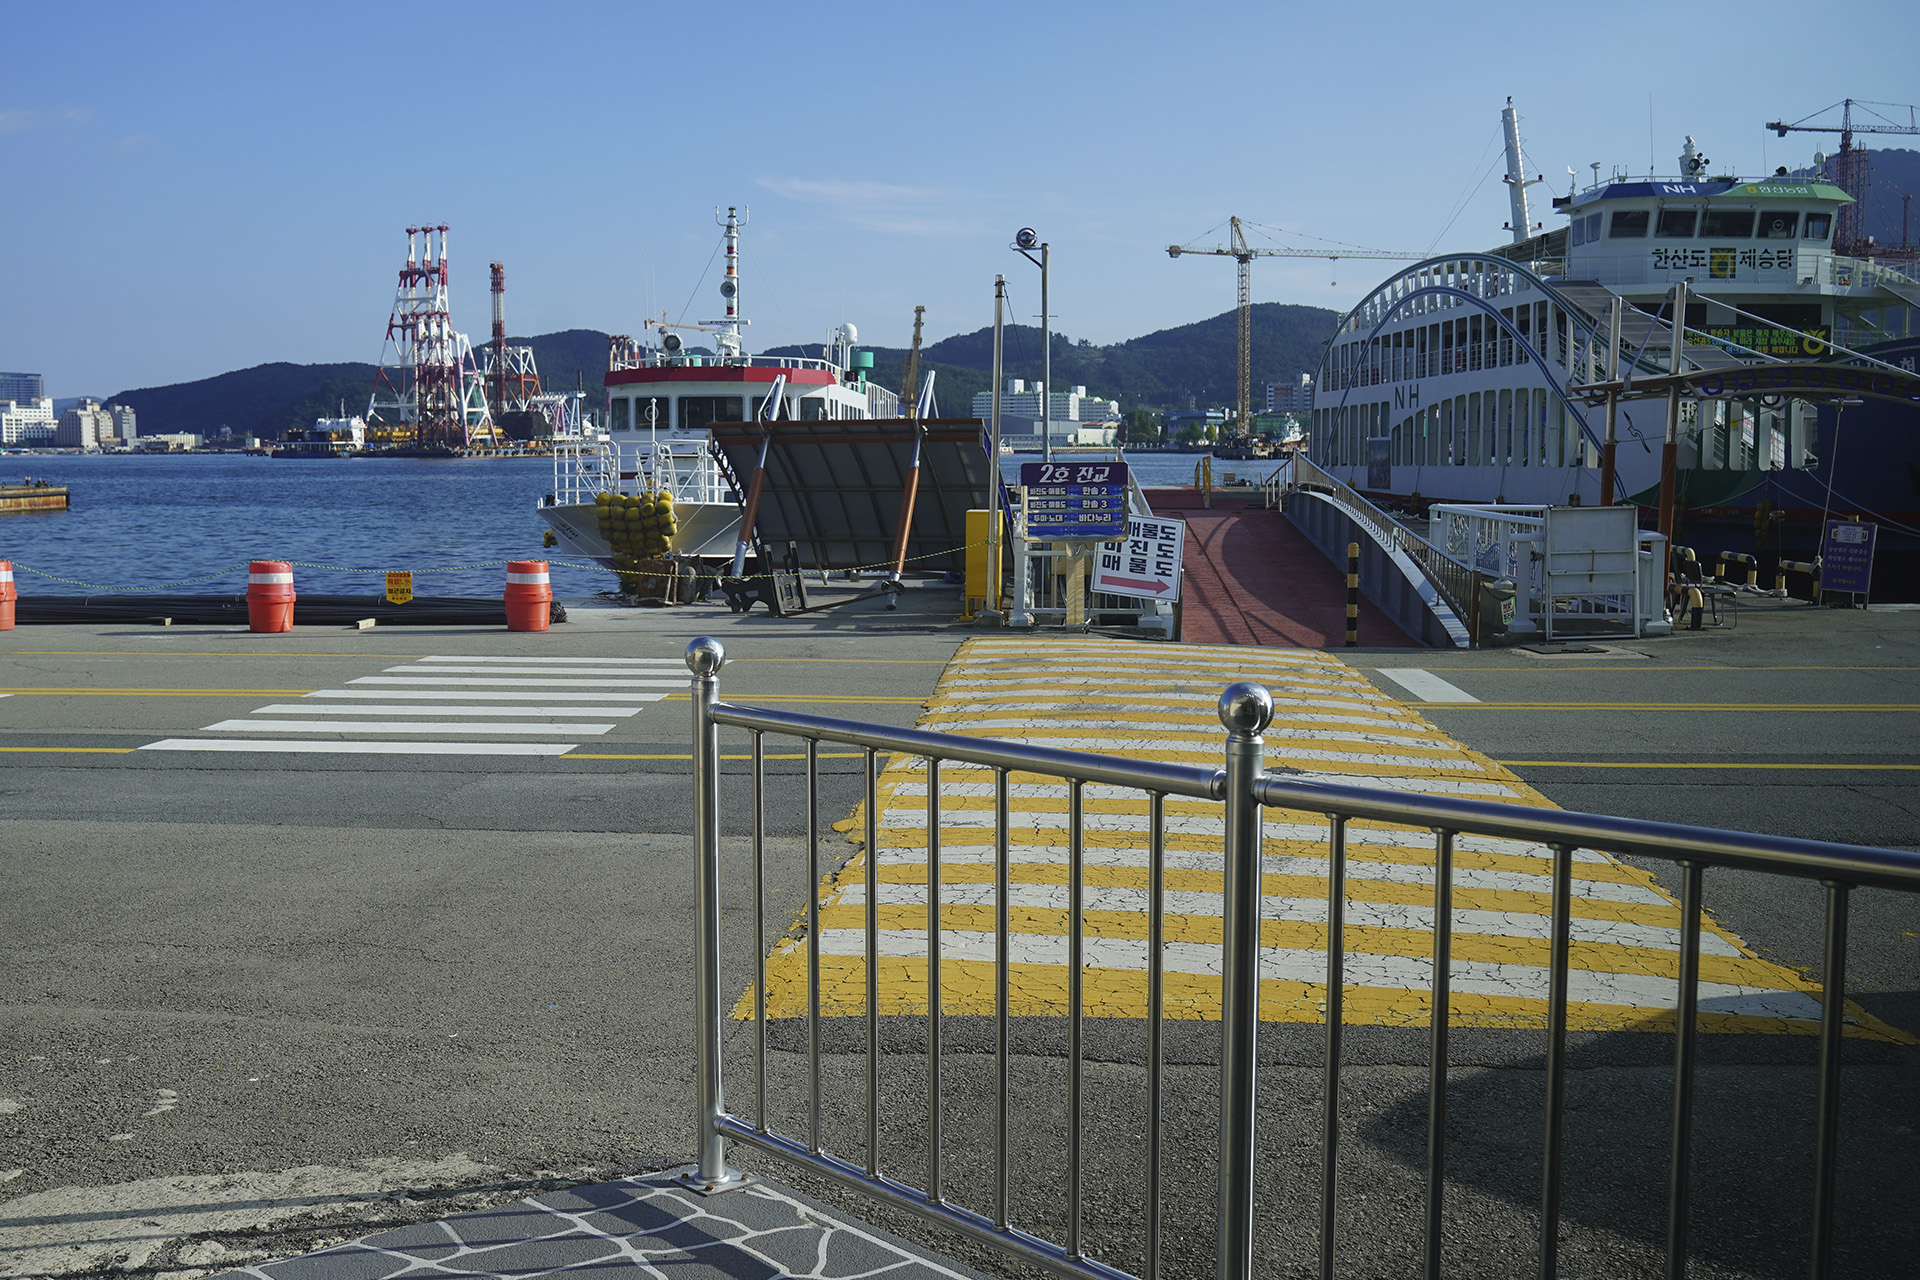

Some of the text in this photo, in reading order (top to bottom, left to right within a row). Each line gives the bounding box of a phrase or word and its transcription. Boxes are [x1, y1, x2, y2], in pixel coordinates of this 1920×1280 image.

[1662, 184, 1697, 194] NH
[1758, 185, 1808, 195] 한산농협
[1651, 248, 1793, 270] 한산도 제승당
[1394, 383, 1420, 411] NH
[1039, 464, 1110, 484] 2호 잔교
[1101, 487, 1108, 496] 2
[1101, 500, 1108, 509] 3
[1078, 513, 1112, 523] 바다누리
